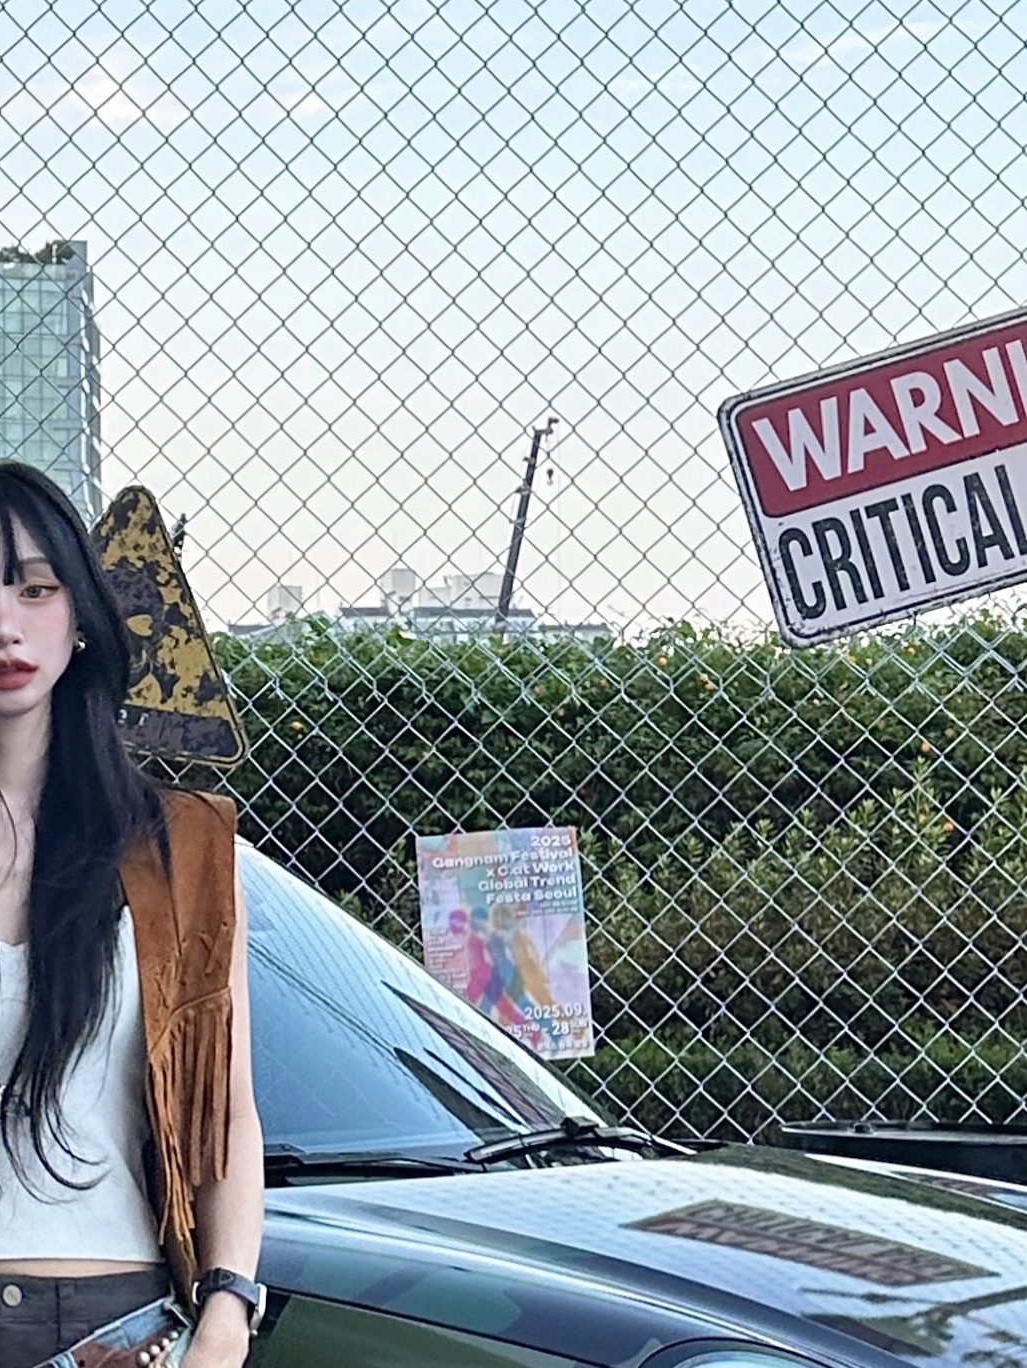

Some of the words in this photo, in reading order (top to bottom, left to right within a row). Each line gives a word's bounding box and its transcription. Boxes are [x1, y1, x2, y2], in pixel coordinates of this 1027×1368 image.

[531, 835, 572, 847] 2025
[432, 853, 509, 869] Gangnam
[511, 847, 574, 862] Festival
[478, 877, 528, 891] Global
[531, 873, 576, 887] Trend
[486, 891, 531, 904] Festa
[533, 886, 578, 899] Seoul
